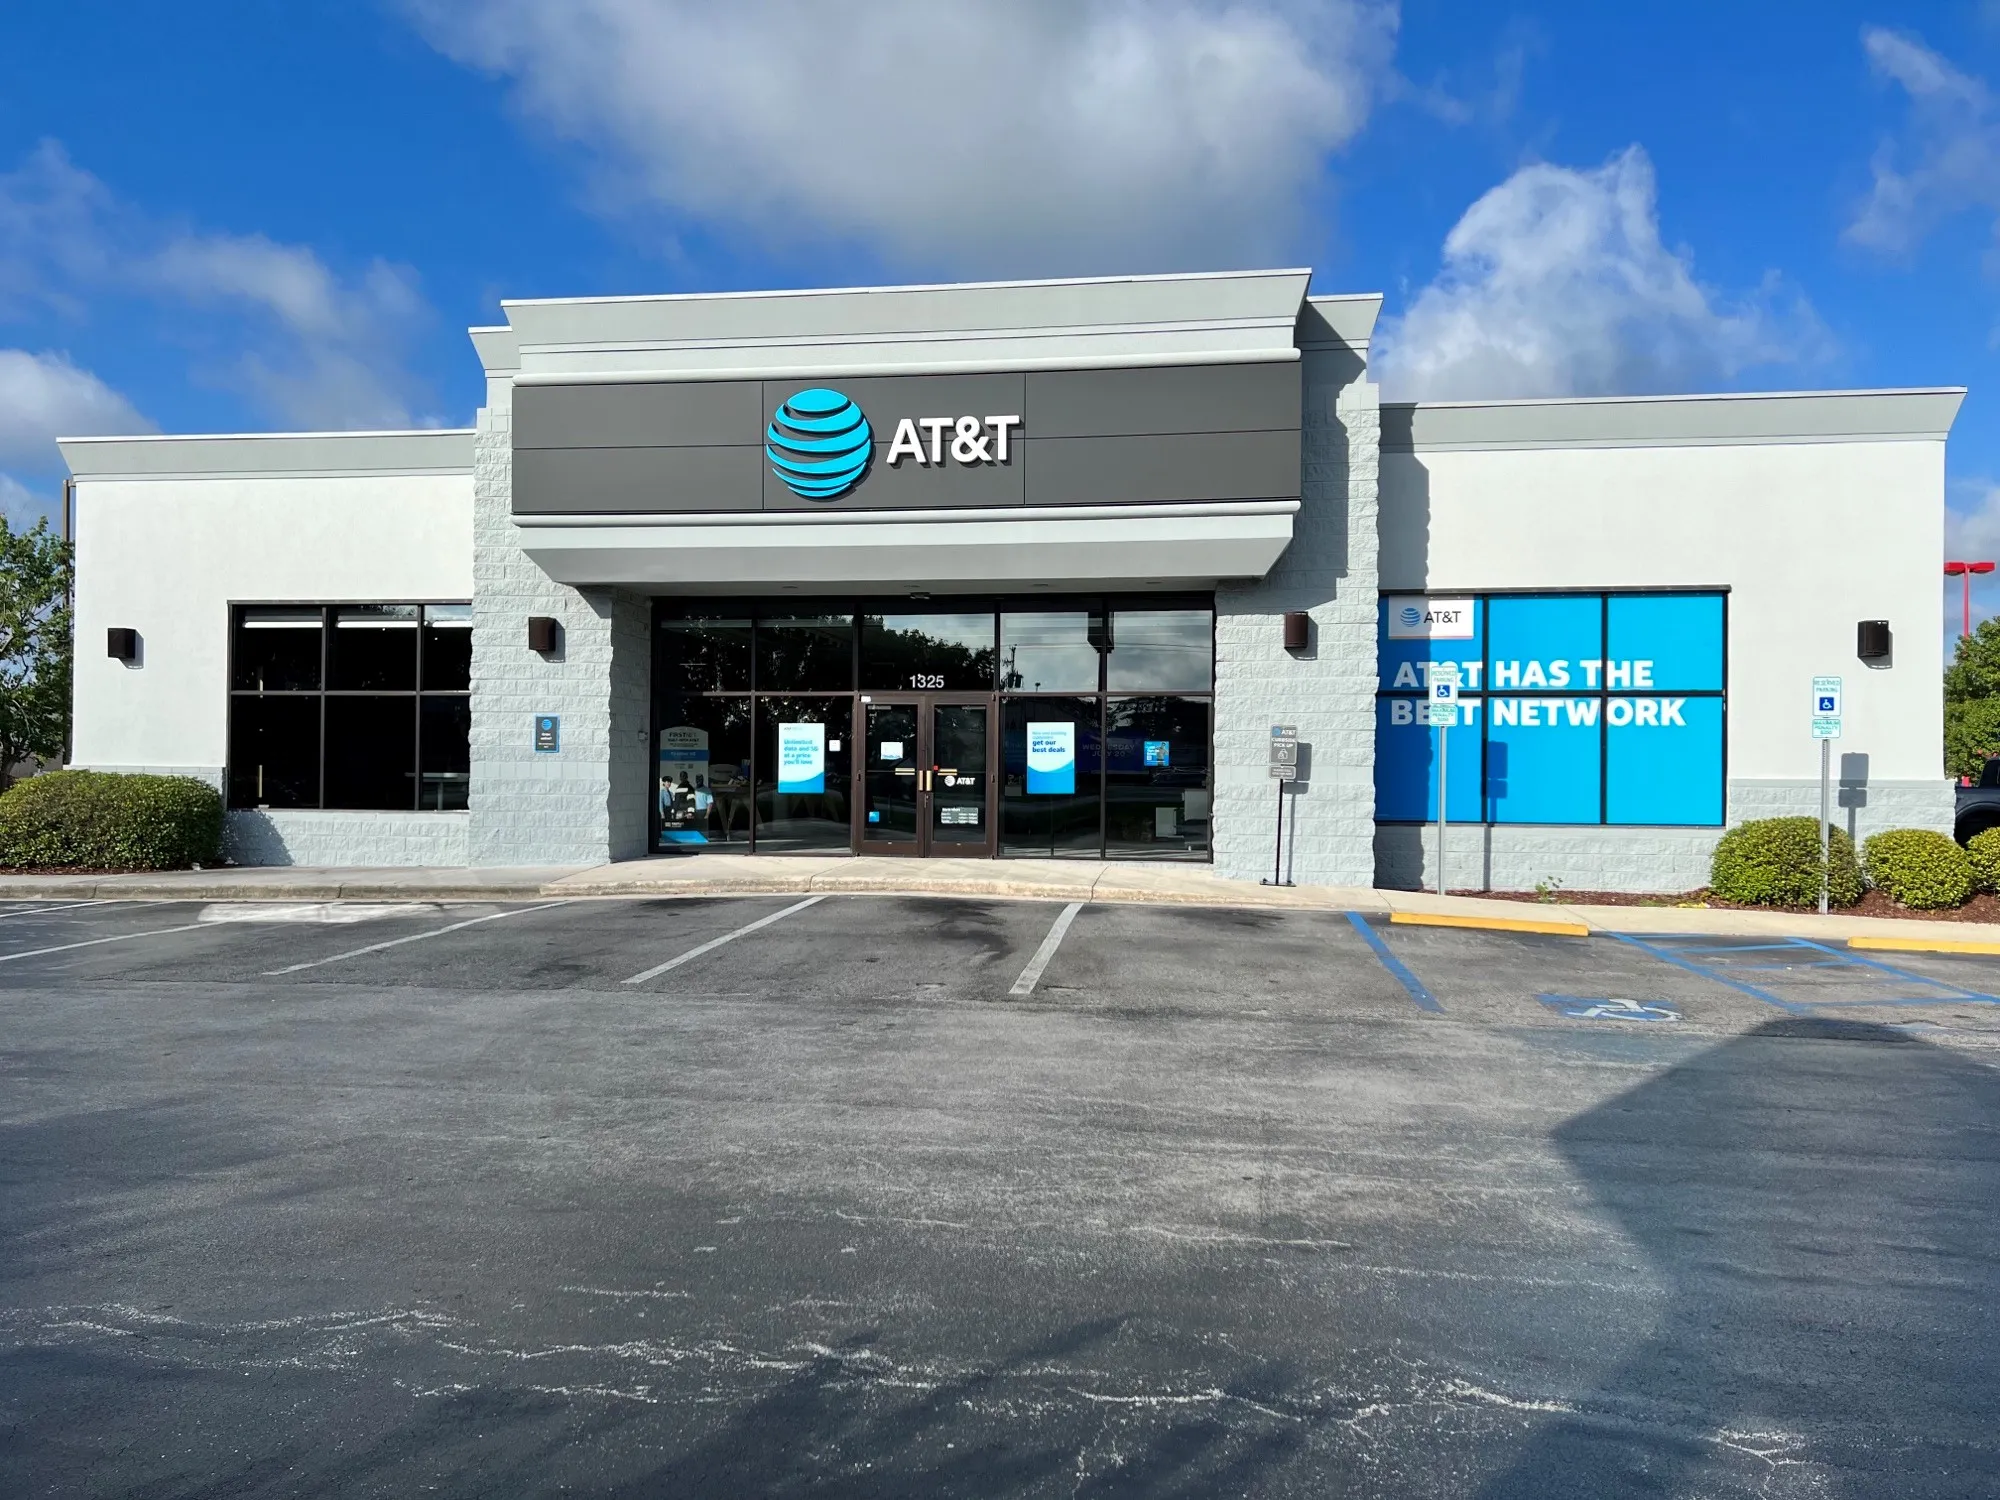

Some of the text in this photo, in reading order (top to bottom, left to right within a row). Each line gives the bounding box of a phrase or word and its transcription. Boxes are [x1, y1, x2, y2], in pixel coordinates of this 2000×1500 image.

[886, 415, 1020, 464] AT&T
[1423, 610, 1462, 624] AT&T
[910, 674, 945, 689] 1325
[1495, 659, 1571, 687] HAS
[1580, 659, 1654, 688] THE
[1391, 698, 1687, 727] BET NETWORK
[956, 777, 976, 785] AT&T
